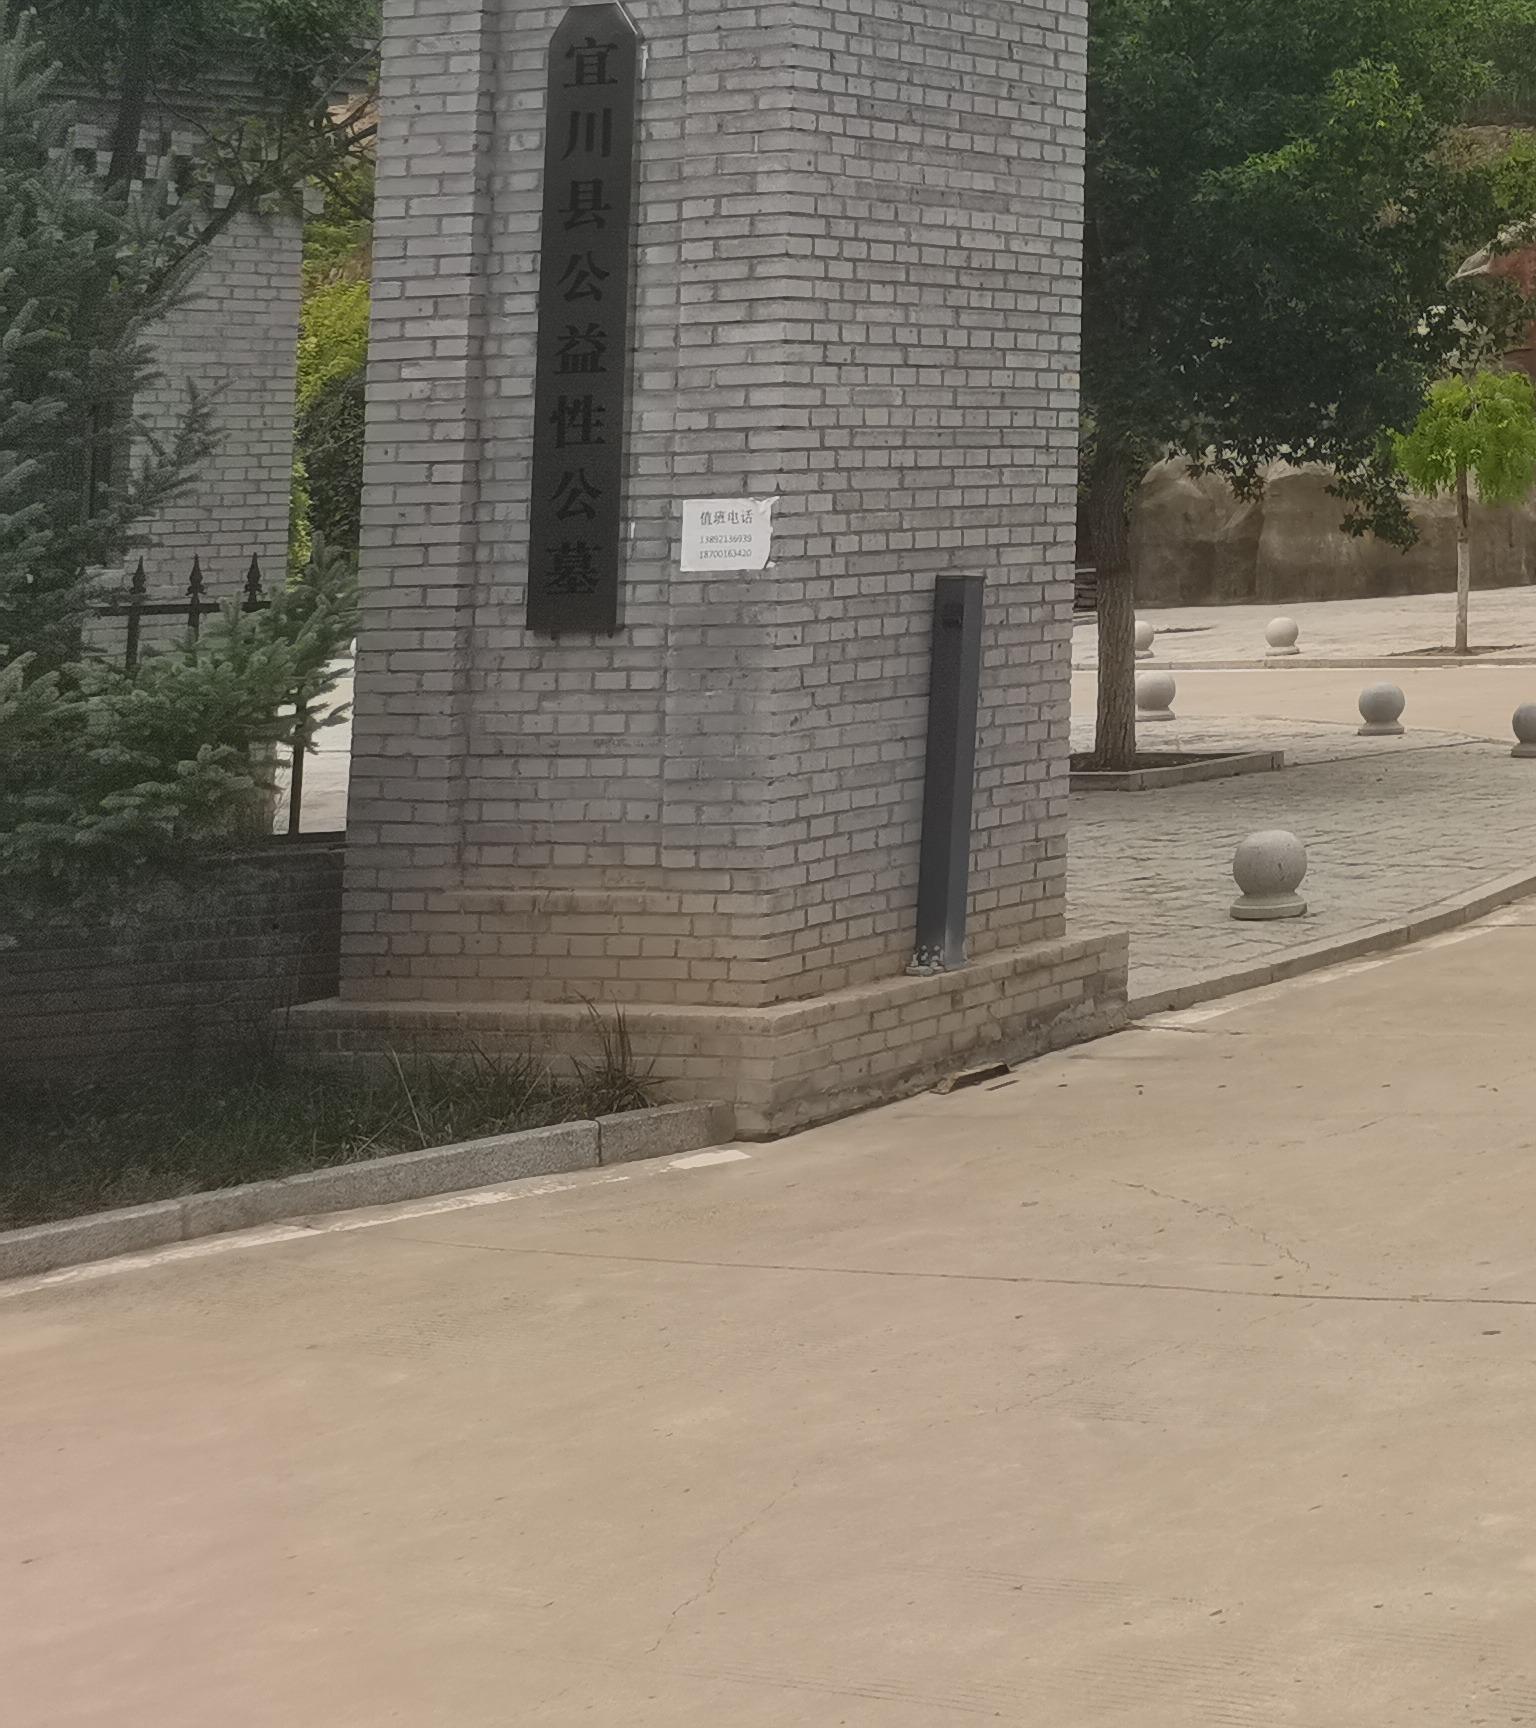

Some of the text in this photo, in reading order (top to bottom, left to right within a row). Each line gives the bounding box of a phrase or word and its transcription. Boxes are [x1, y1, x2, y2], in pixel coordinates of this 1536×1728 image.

[544, 36, 619, 596] 宜川县公益性公墓
[700, 509, 753, 526] 值班电话
